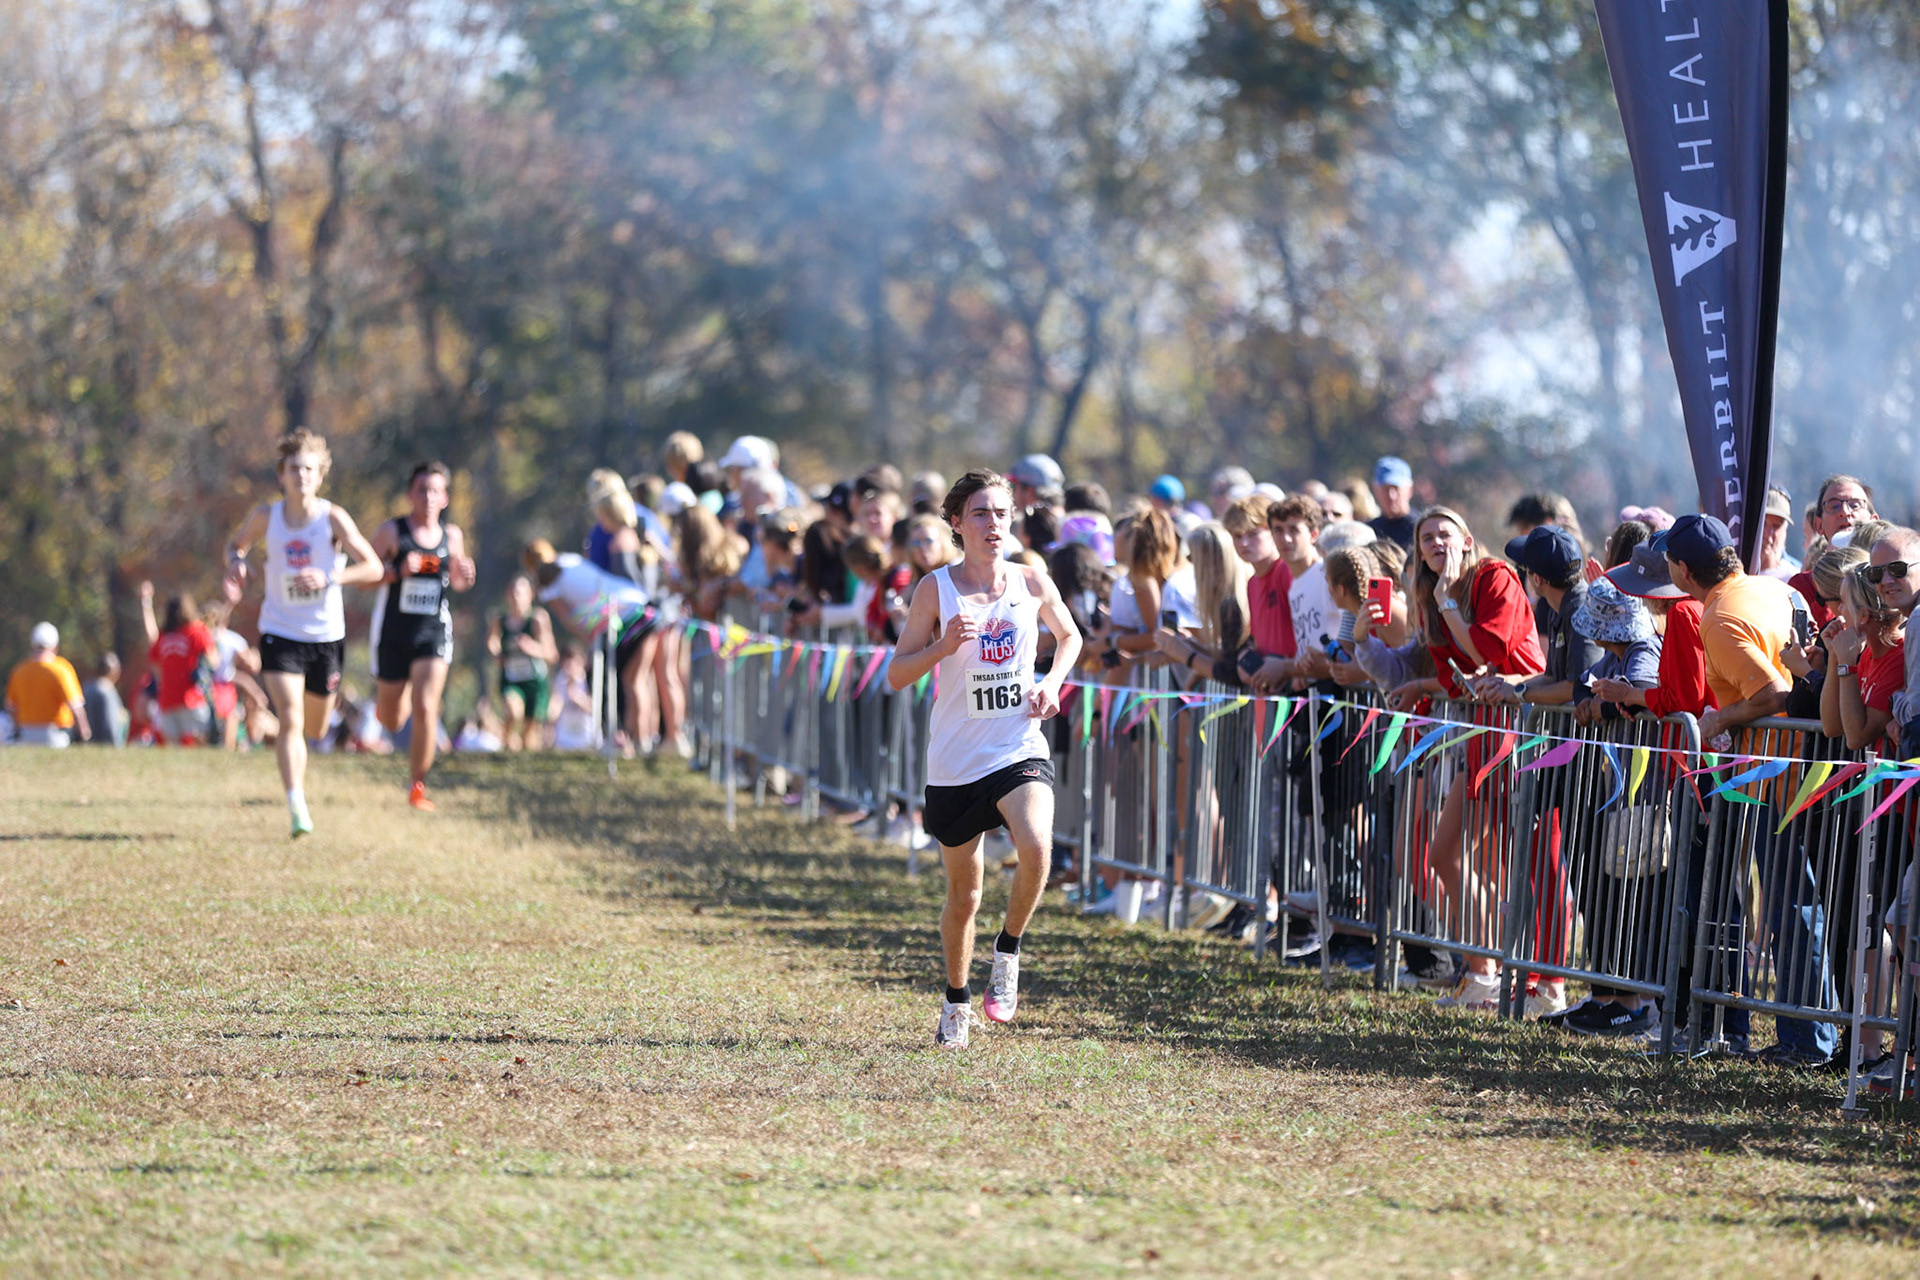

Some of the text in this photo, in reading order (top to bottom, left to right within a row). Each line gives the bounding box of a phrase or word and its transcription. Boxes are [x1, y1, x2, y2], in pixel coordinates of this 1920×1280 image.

[983, 636, 1013, 660] MUS
[972, 673, 995, 682] TMSAA
[996, 671, 1013, 681] STATE
[972, 683, 1021, 710] 1163
[1610, 1013, 1632, 1026] HOKA
